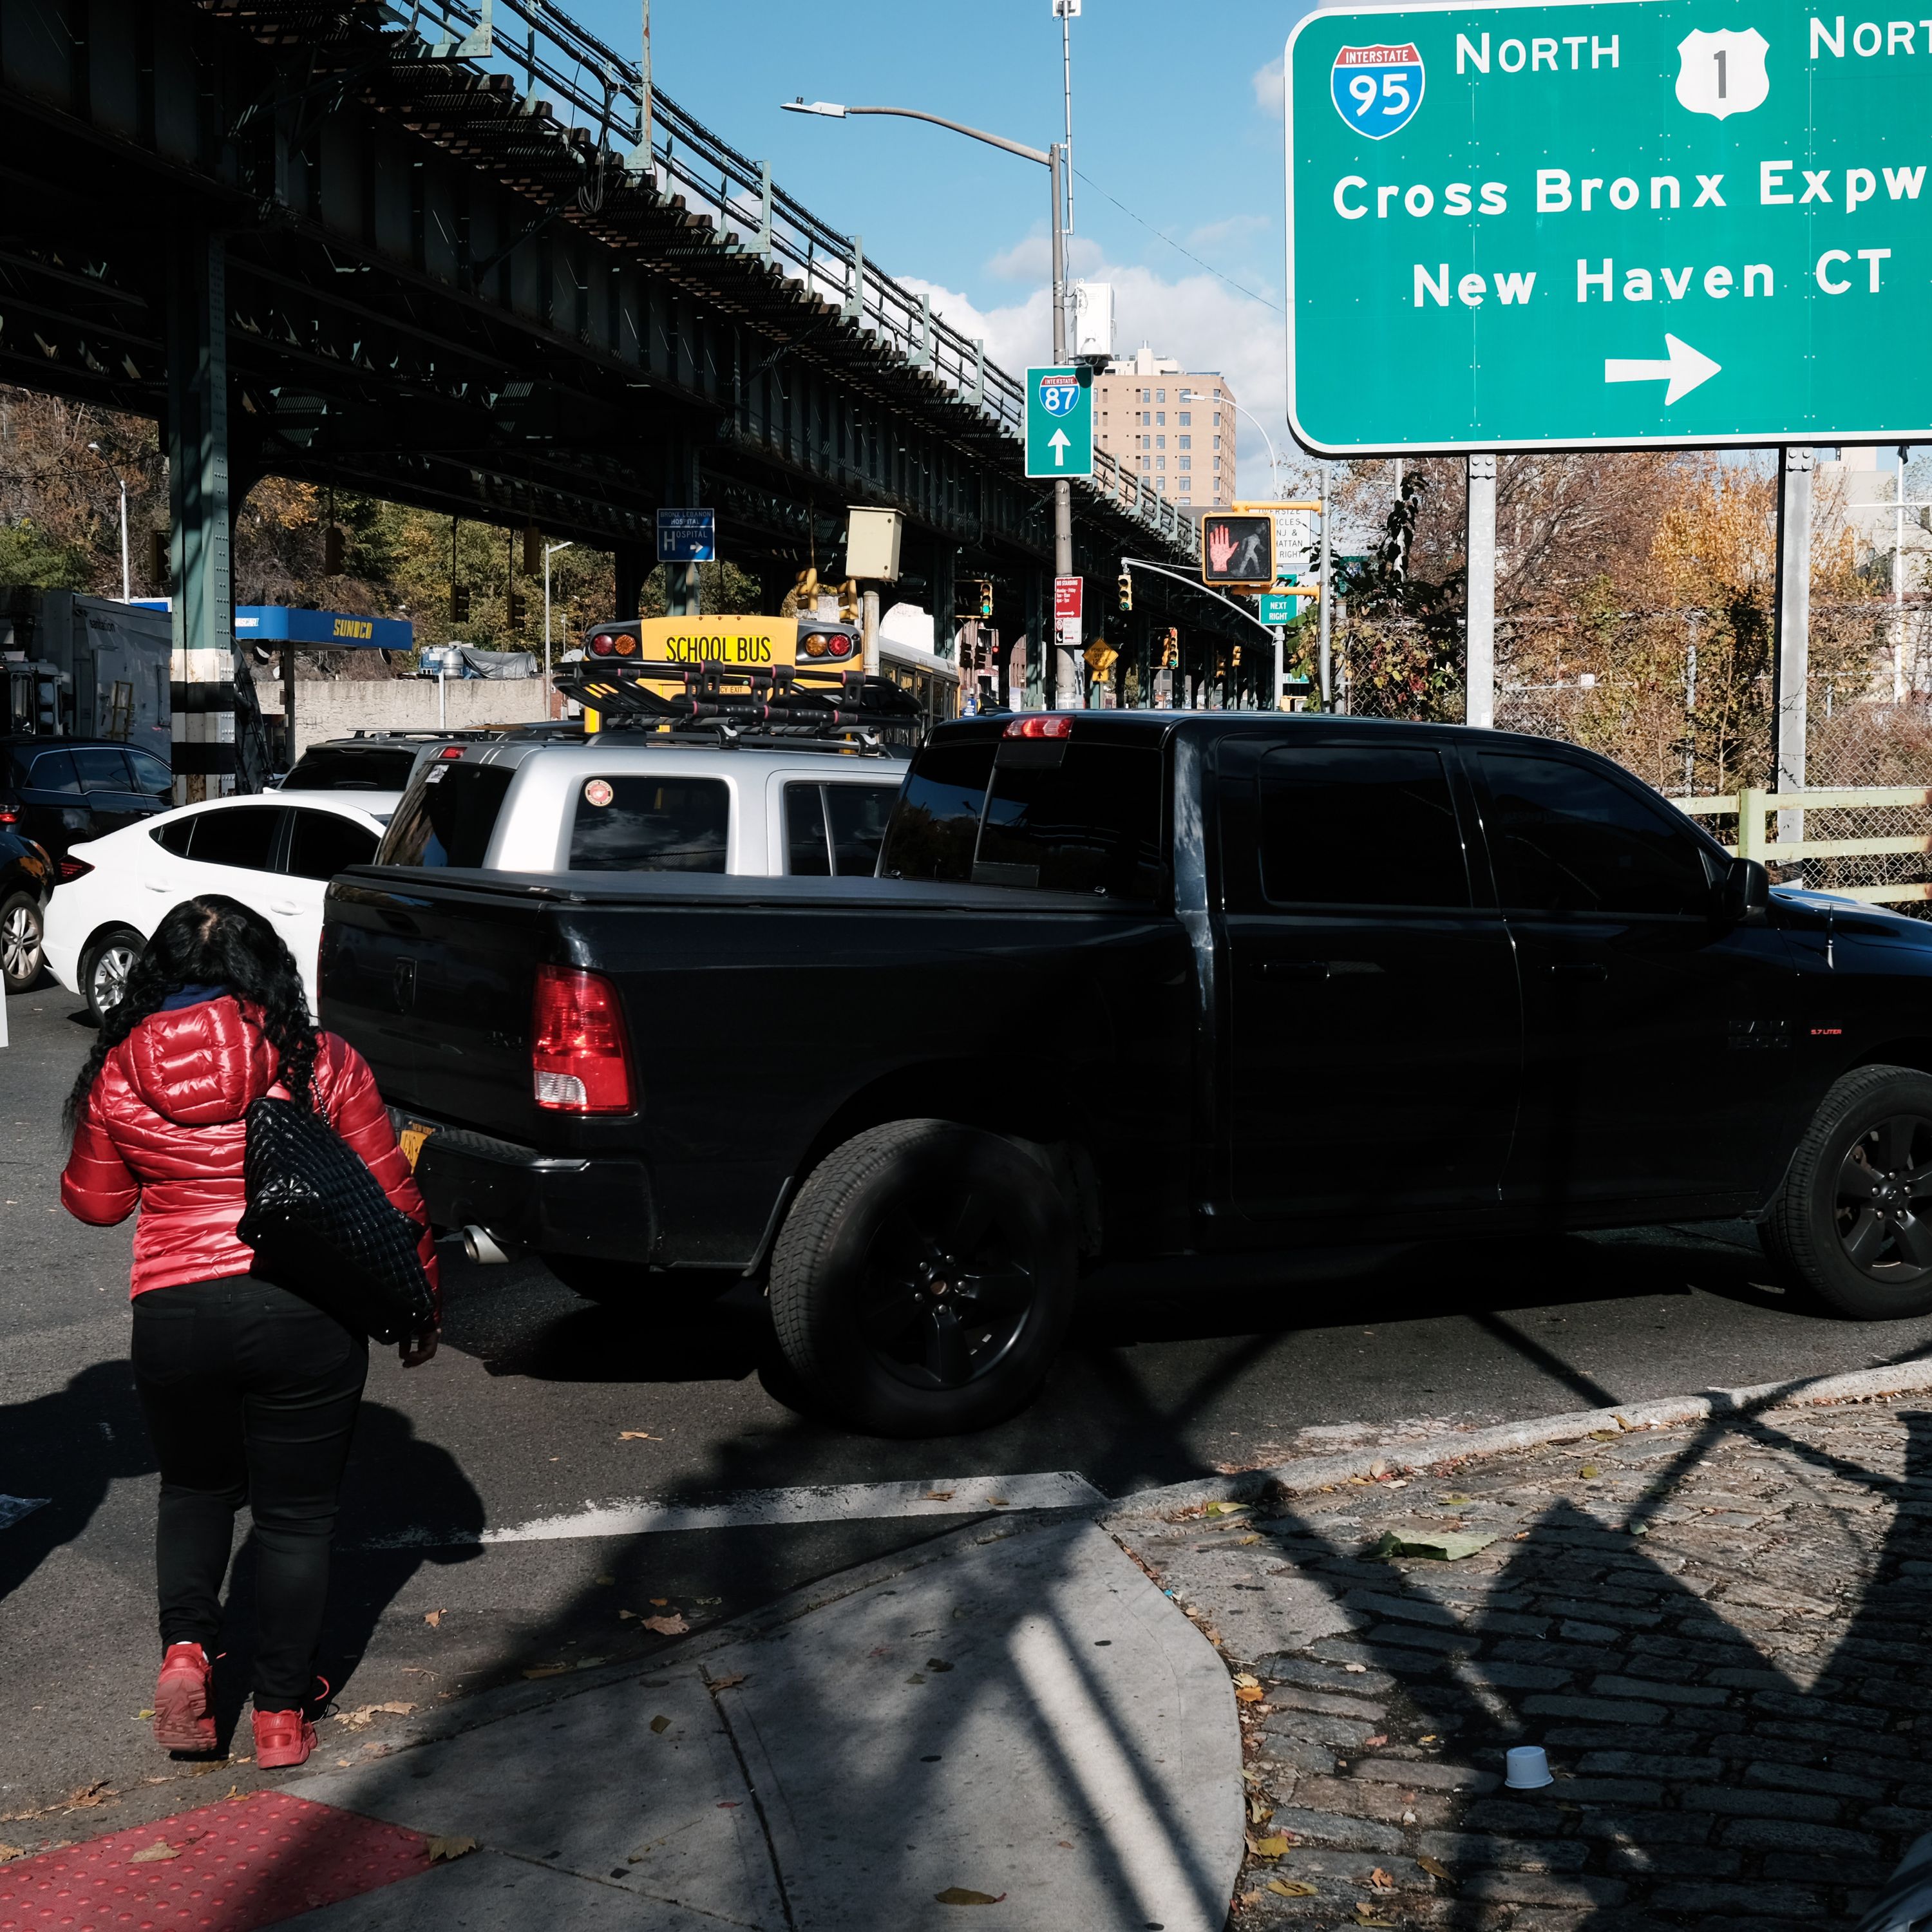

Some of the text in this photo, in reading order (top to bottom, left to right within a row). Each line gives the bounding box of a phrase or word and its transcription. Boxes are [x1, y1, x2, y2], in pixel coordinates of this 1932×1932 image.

[1345, 50, 1410, 64] INTERSTATE
[1456, 33, 1619, 74] NORTH
[1713, 50, 1727, 99] 1
[1349, 73, 1410, 117] 95
[1334, 160, 1927, 220] Cross Bronx Expw
[1414, 249, 1891, 307] New Haven CT
[1045, 388, 1075, 410] 87
[664, 531, 708, 551] HOSPITAL
[1270, 601, 1287, 610] NEXT
[333, 618, 373, 639] SUNOCO
[666, 636, 771, 663] SCHOOL BUS
